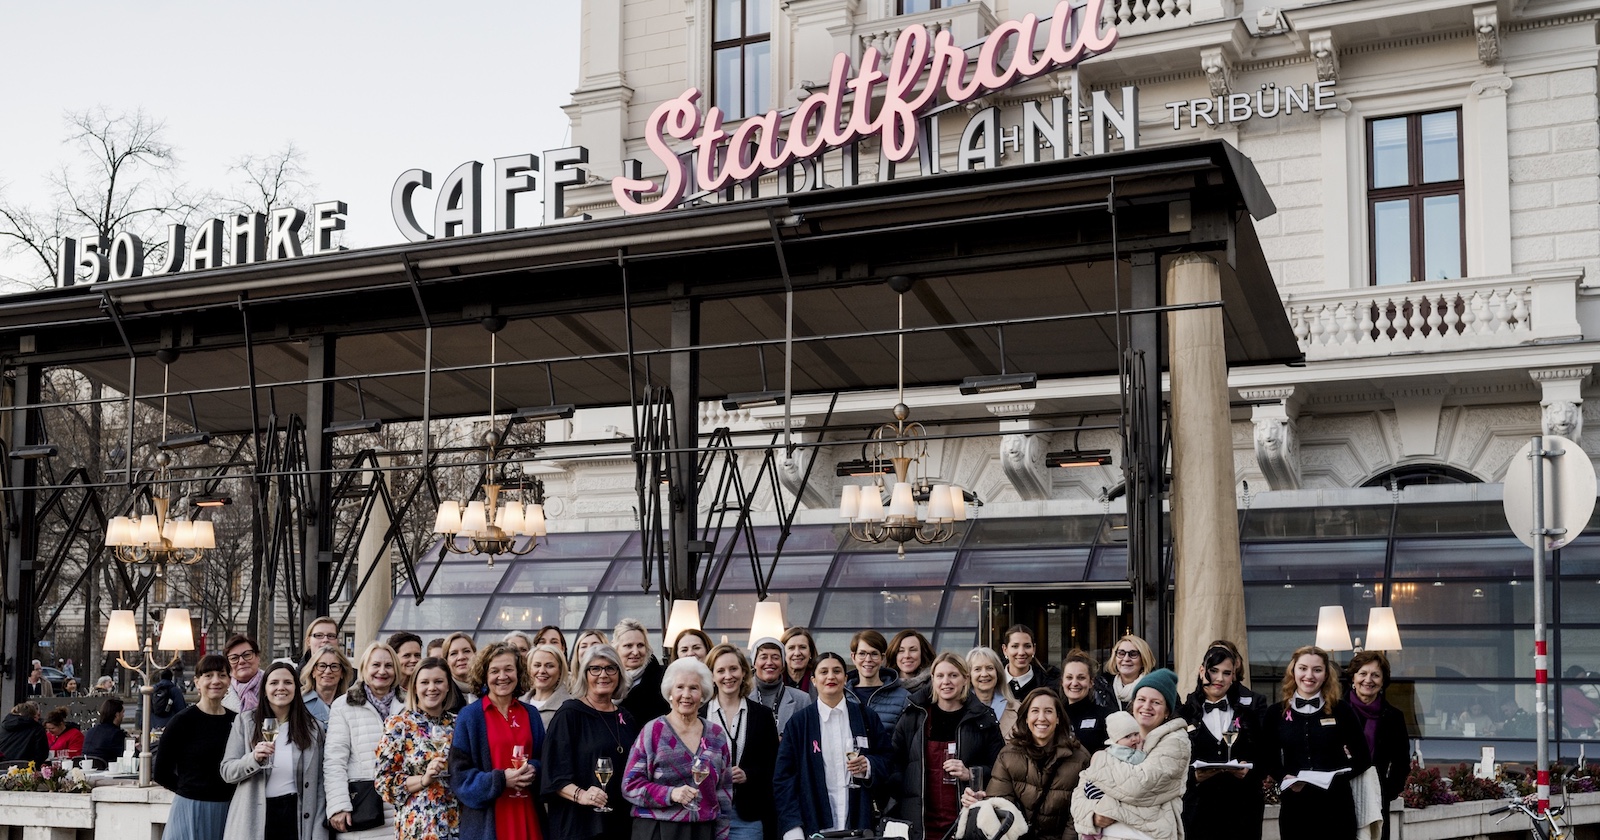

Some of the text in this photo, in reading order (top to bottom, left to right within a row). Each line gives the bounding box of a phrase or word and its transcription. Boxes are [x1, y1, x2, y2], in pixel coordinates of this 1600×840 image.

[612, 0, 1120, 214] Stadtfrau
[1165, 81, 1337, 130] TRIBÜNE
[391, 146, 592, 243] CAFE
[58, 200, 348, 288] 150 JAHRE
